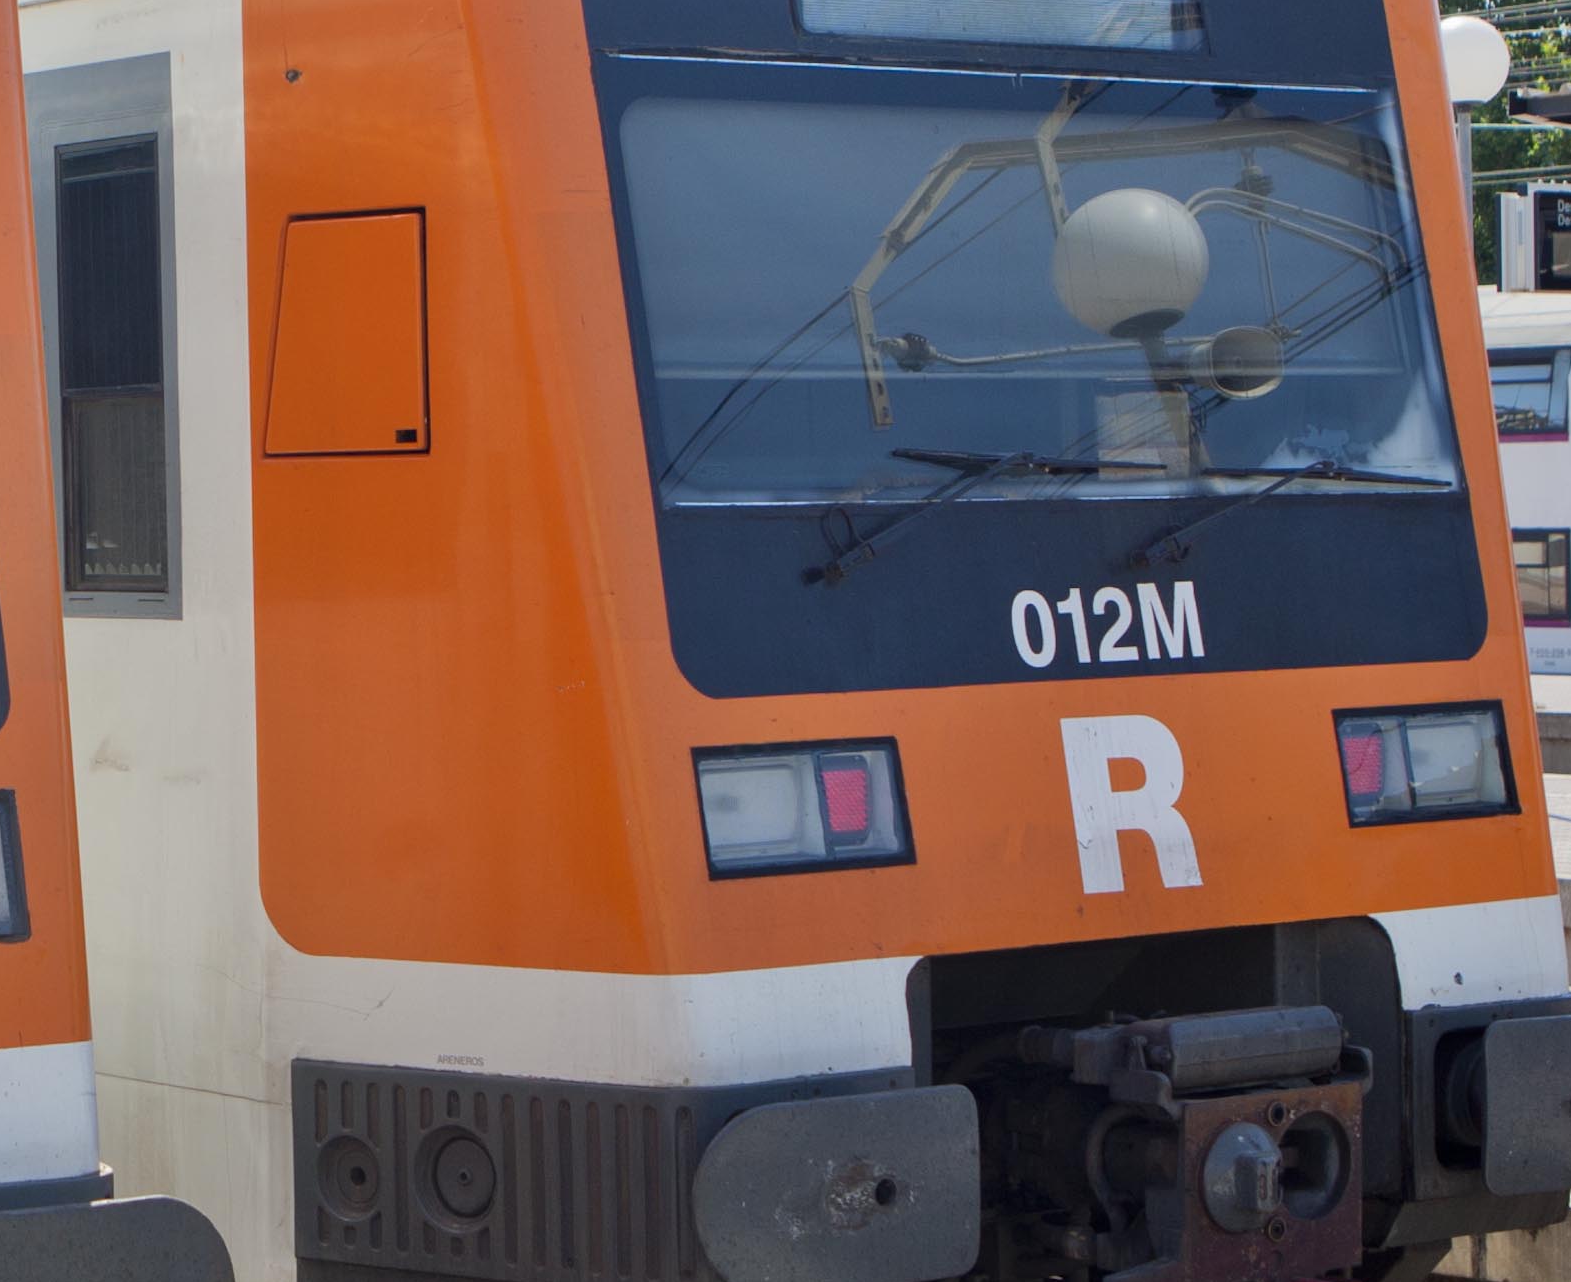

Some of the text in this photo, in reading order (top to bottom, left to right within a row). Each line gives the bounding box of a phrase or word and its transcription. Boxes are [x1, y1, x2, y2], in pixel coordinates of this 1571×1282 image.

[1011, 580, 1205, 668] 012M
[1060, 714, 1204, 894] R
[438, 1054, 485, 1067] ARENEROS
